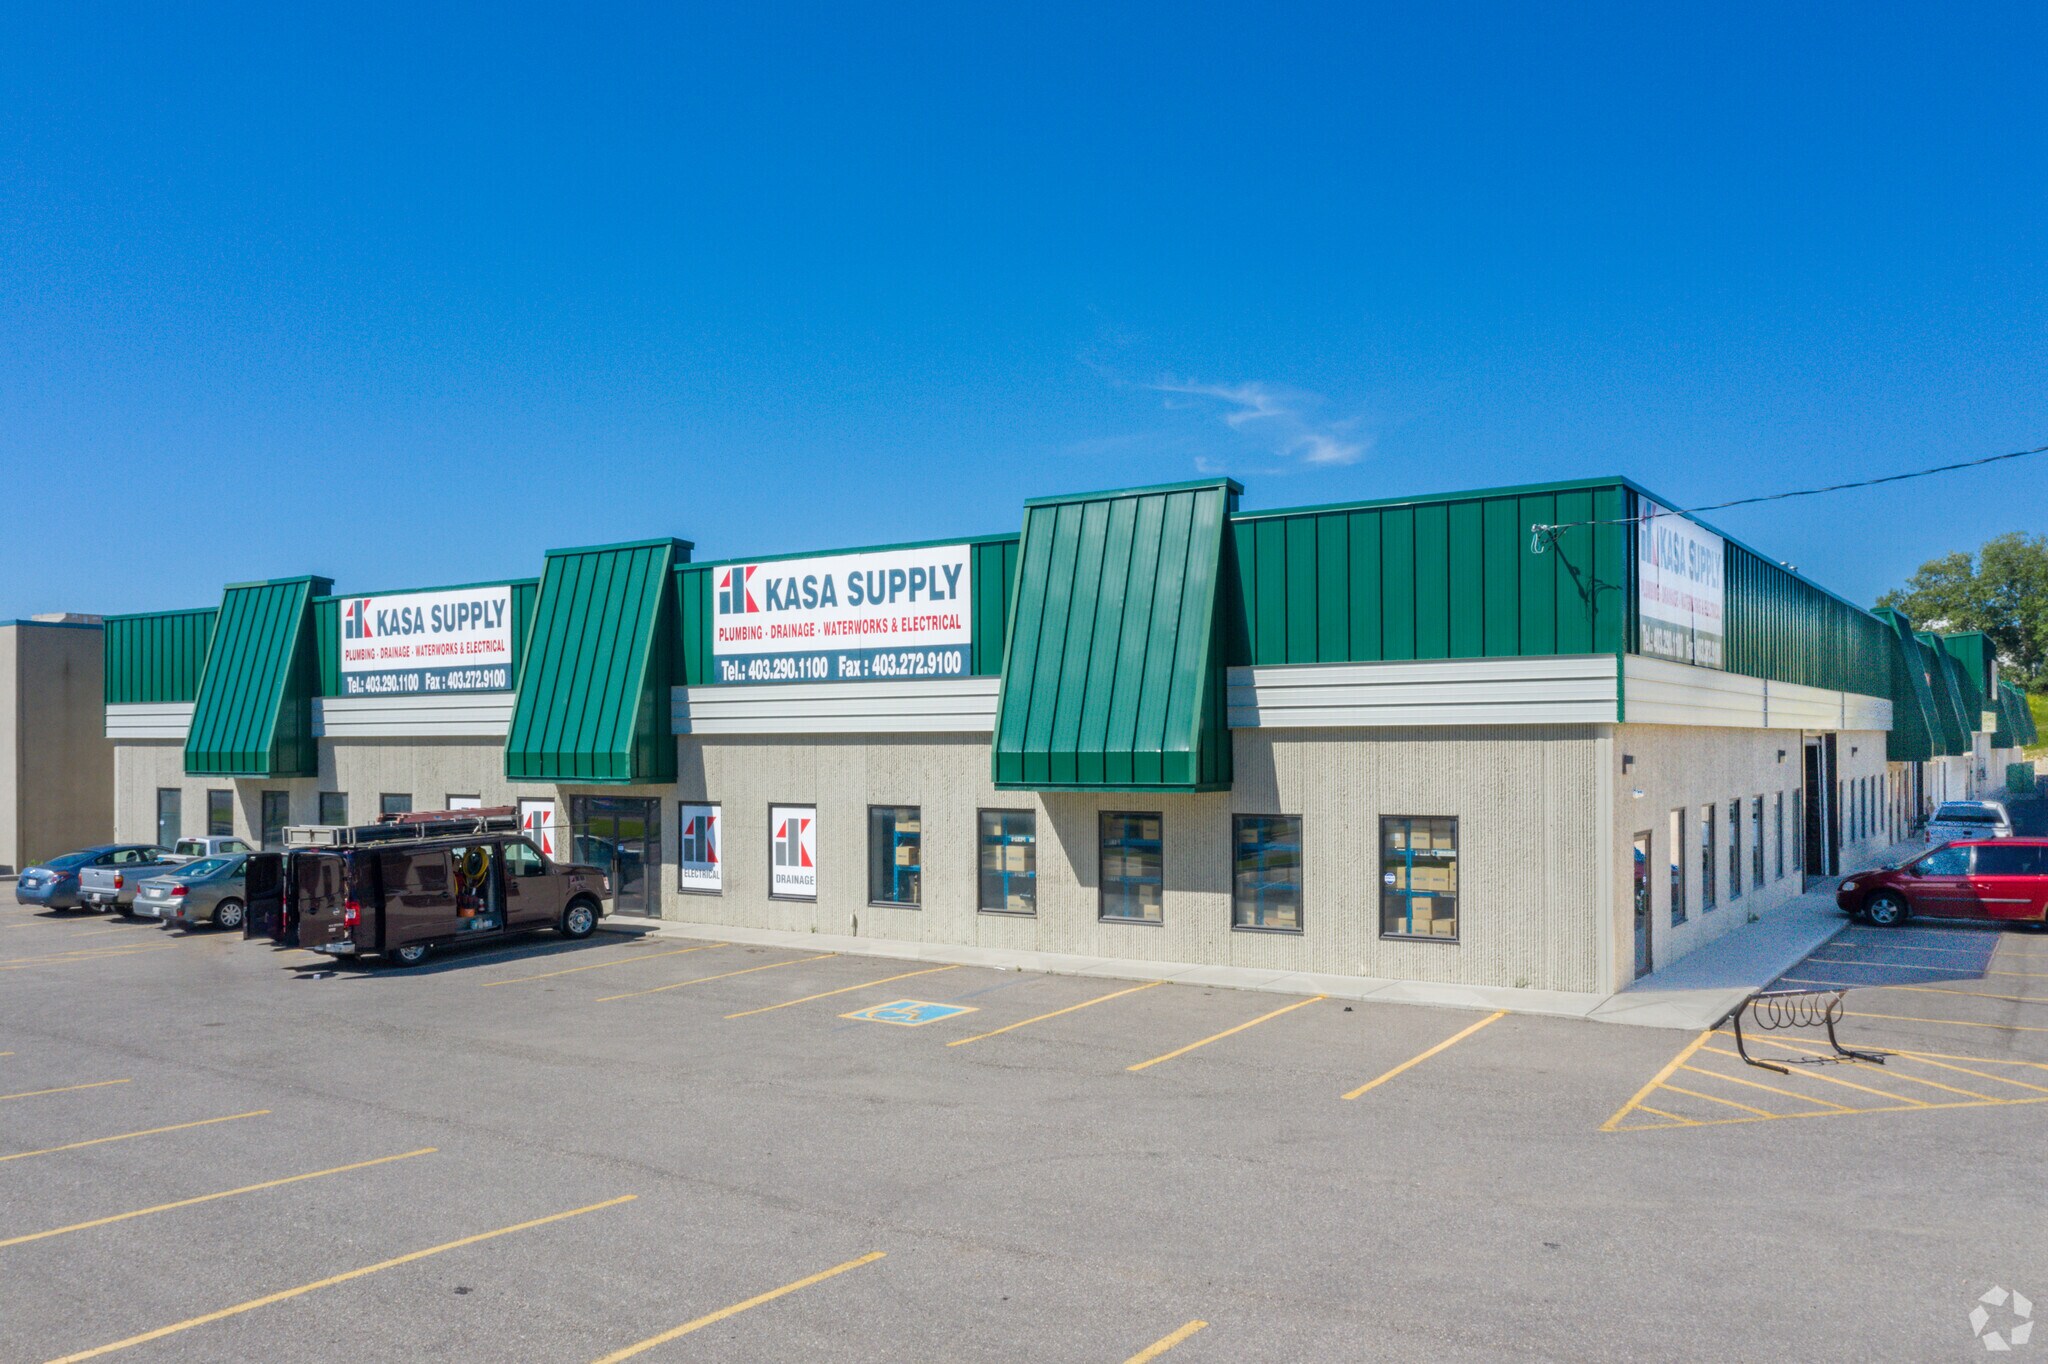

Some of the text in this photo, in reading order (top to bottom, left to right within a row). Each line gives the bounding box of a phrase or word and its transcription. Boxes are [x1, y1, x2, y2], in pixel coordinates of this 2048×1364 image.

[1660, 526, 1721, 589] KASA SUPPLY
[766, 563, 963, 612] KASA SUPPLY
[377, 598, 506, 637] KASA SUPPLY
[719, 614, 961, 642] PLUMBING DRAINAGE WATERWORKS & ELECTRICAL
[345, 639, 505, 662] PLUMBING DRAINAGE WATERWORKS & ELECTRICAL
[721, 660, 746, 681] Tel.:
[748, 656, 828, 680] 403.290.1100
[838, 655, 861, 678] Fax
[871, 651, 962, 676] 403.272.9100
[365, 673, 419, 693] 403.290.1100
[425, 672, 440, 690] Fax
[447, 669, 505, 690] 403.272.9100
[684, 869, 720, 880] ELECTRICAL
[775, 874, 815, 885] DRAINAGE
